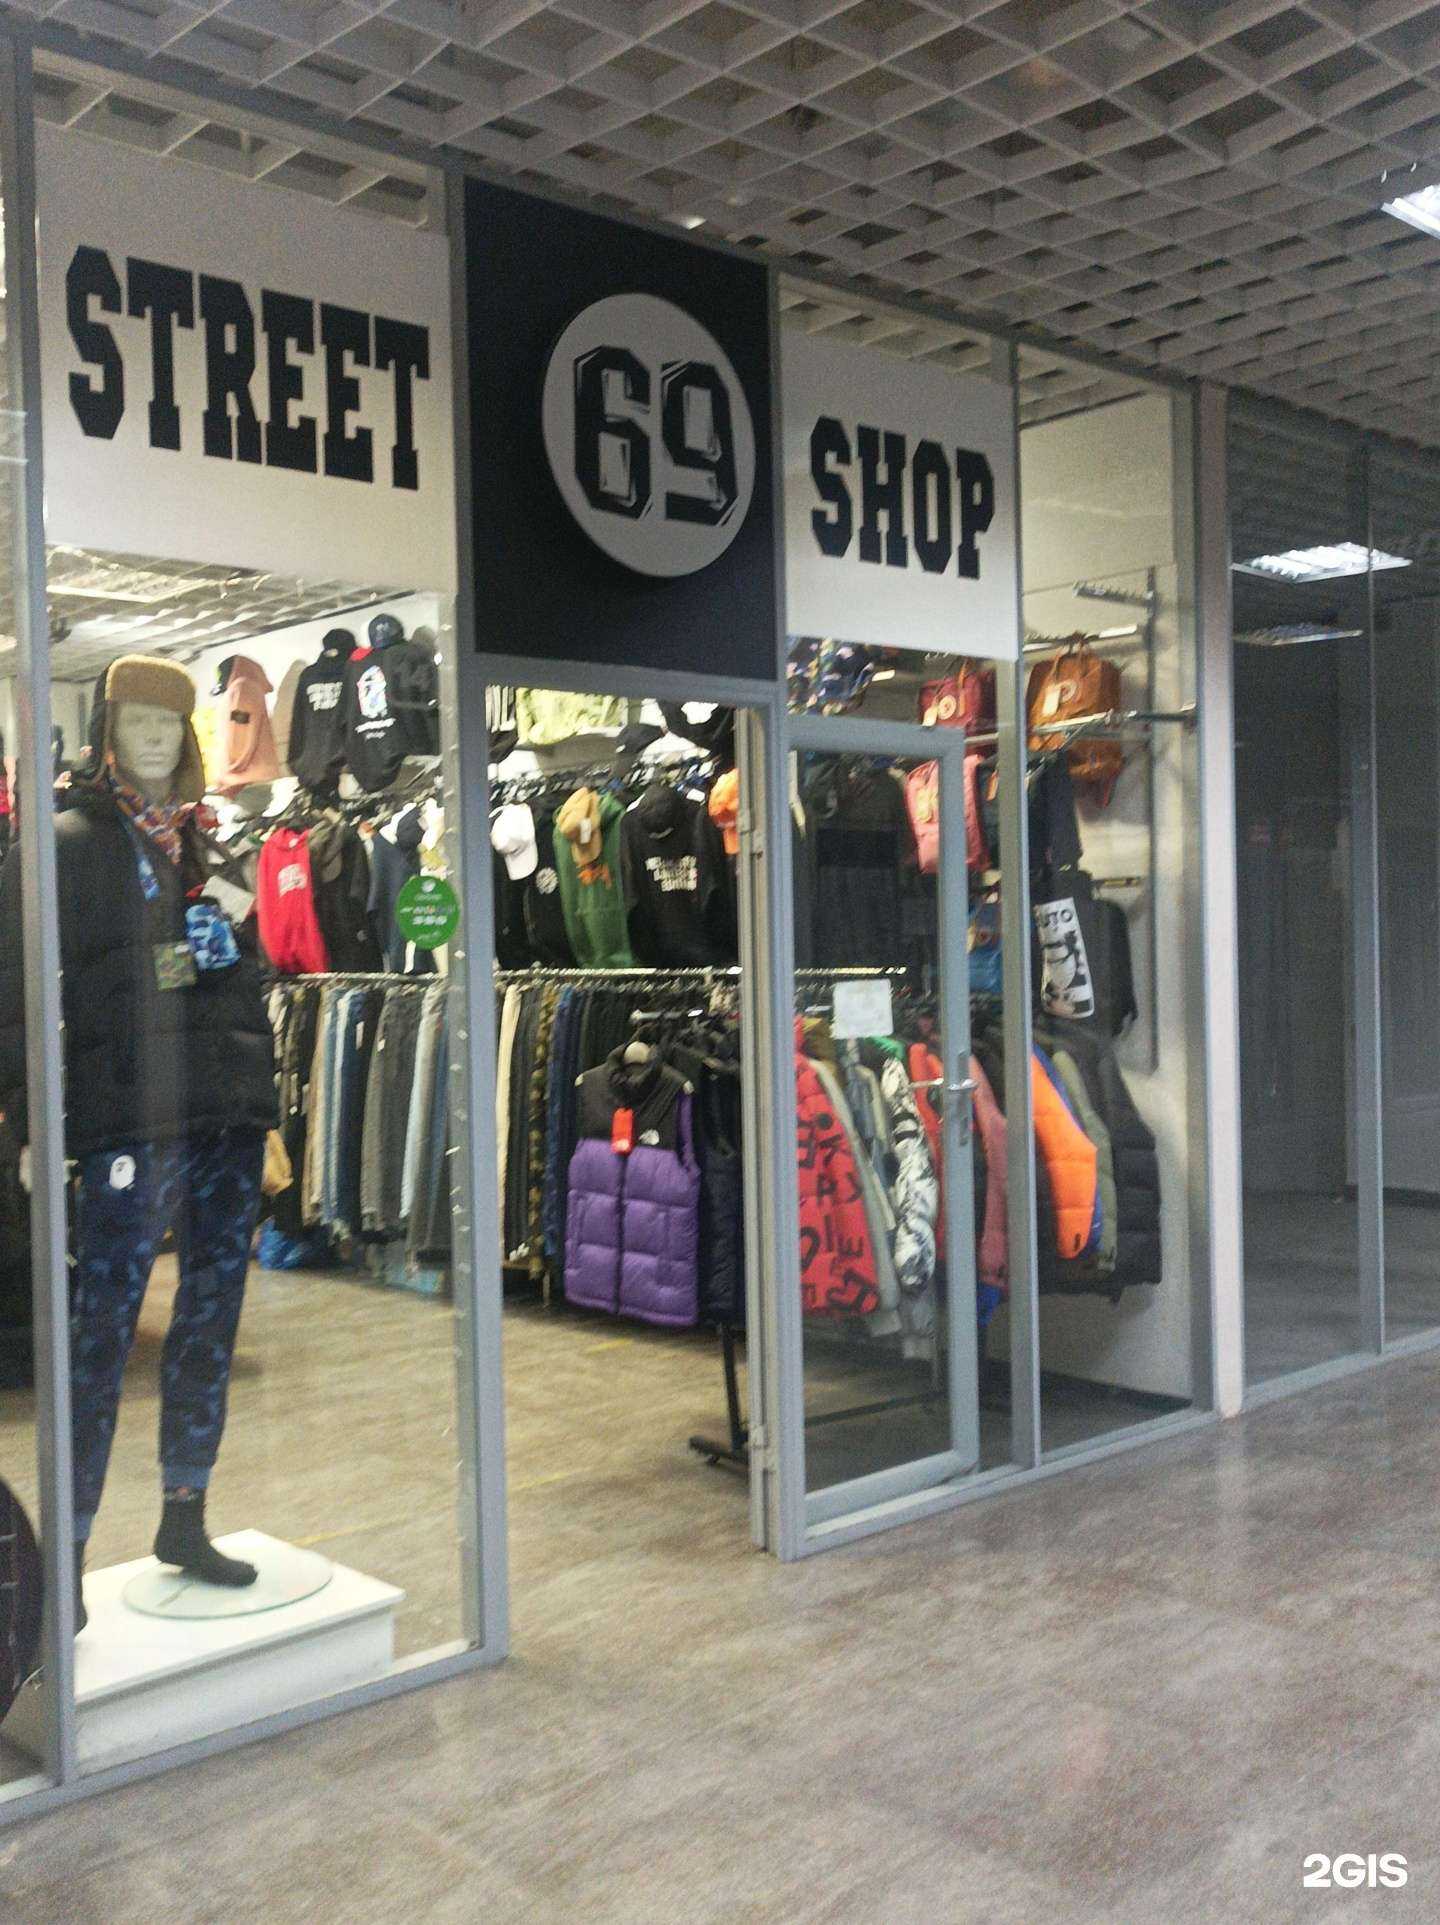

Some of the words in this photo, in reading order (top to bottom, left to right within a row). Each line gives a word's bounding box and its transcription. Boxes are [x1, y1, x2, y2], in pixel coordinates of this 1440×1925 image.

[66, 245, 430, 491] STREET
[574, 345, 738, 527] 69
[810, 415, 995, 581] SHOP
